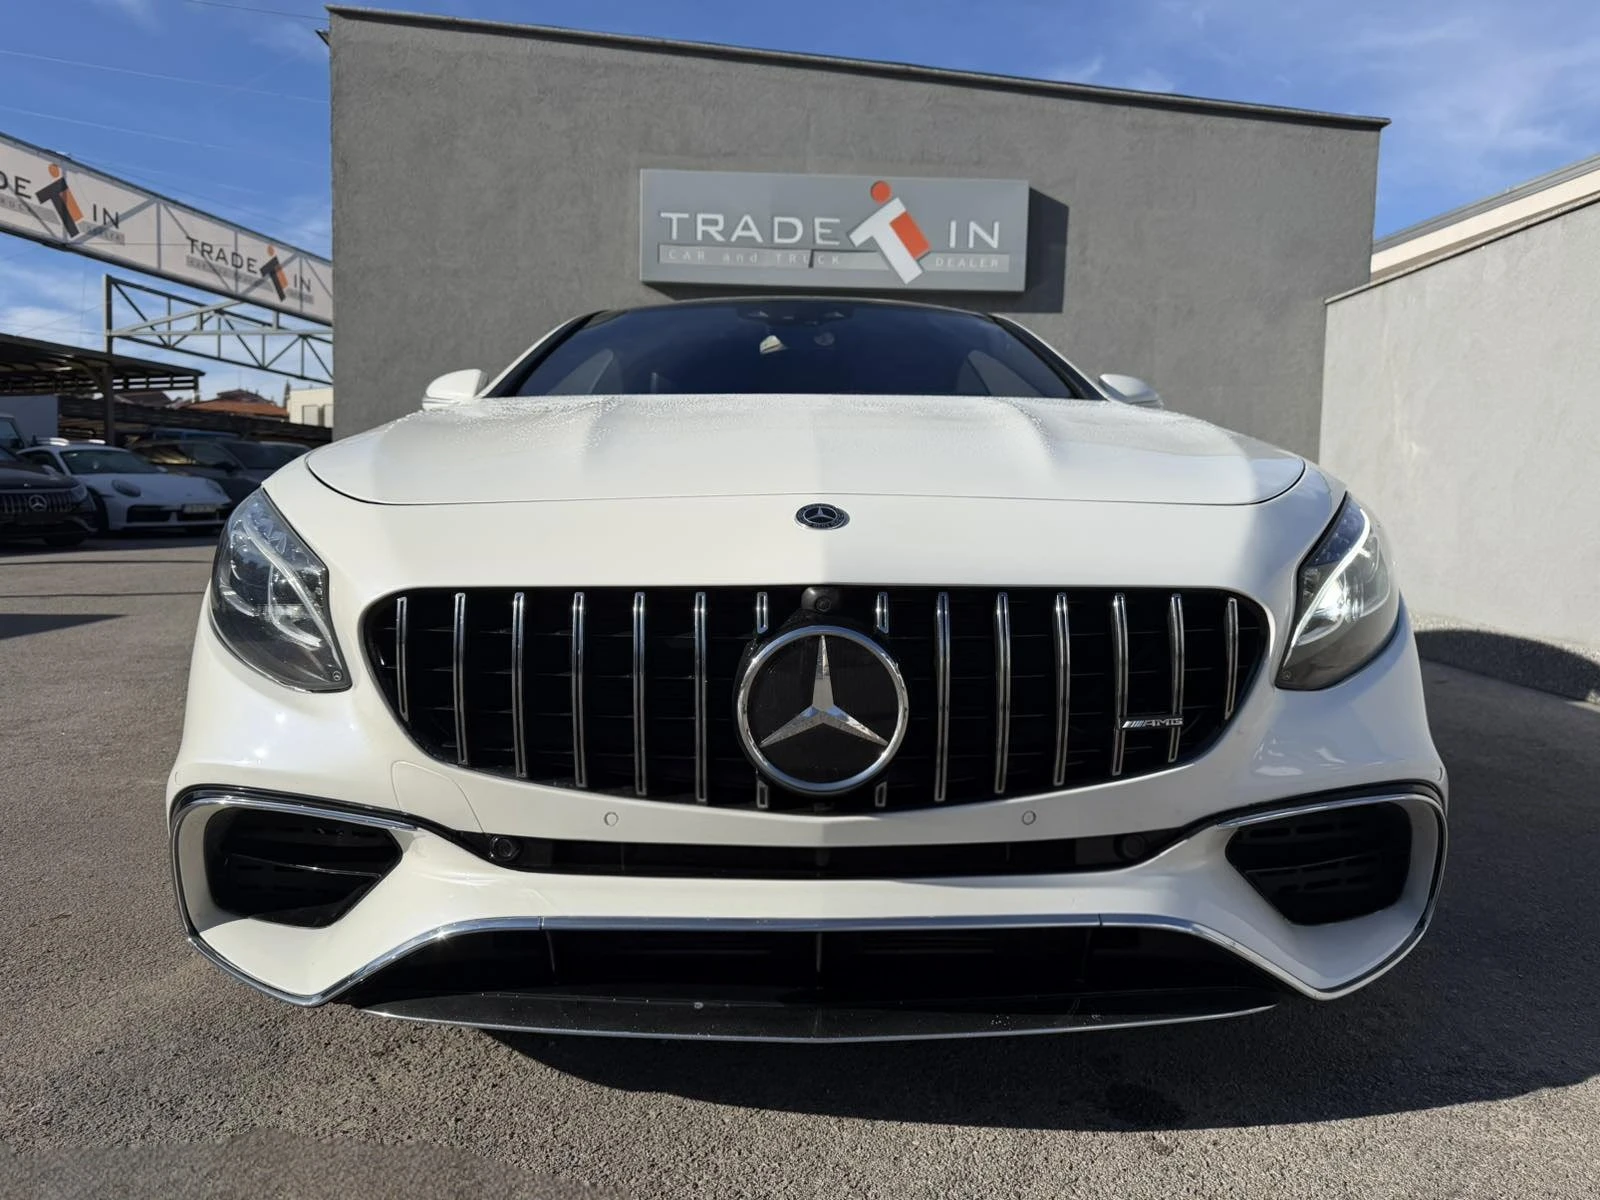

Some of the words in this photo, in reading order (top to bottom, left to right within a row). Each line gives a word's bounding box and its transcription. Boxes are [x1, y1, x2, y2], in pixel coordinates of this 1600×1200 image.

[93, 203, 119, 229] IN
[660, 211, 841, 246] TRADE
[949, 220, 1000, 249] IN
[186, 235, 257, 274] TRADE
[293, 273, 311, 292] IN
[668, 249, 705, 261] CAR
[722, 252, 758, 263] and
[775, 253, 841, 266] TRUCK
[935, 256, 999, 269] DEALER
[1144, 718, 1183, 727] AMG
